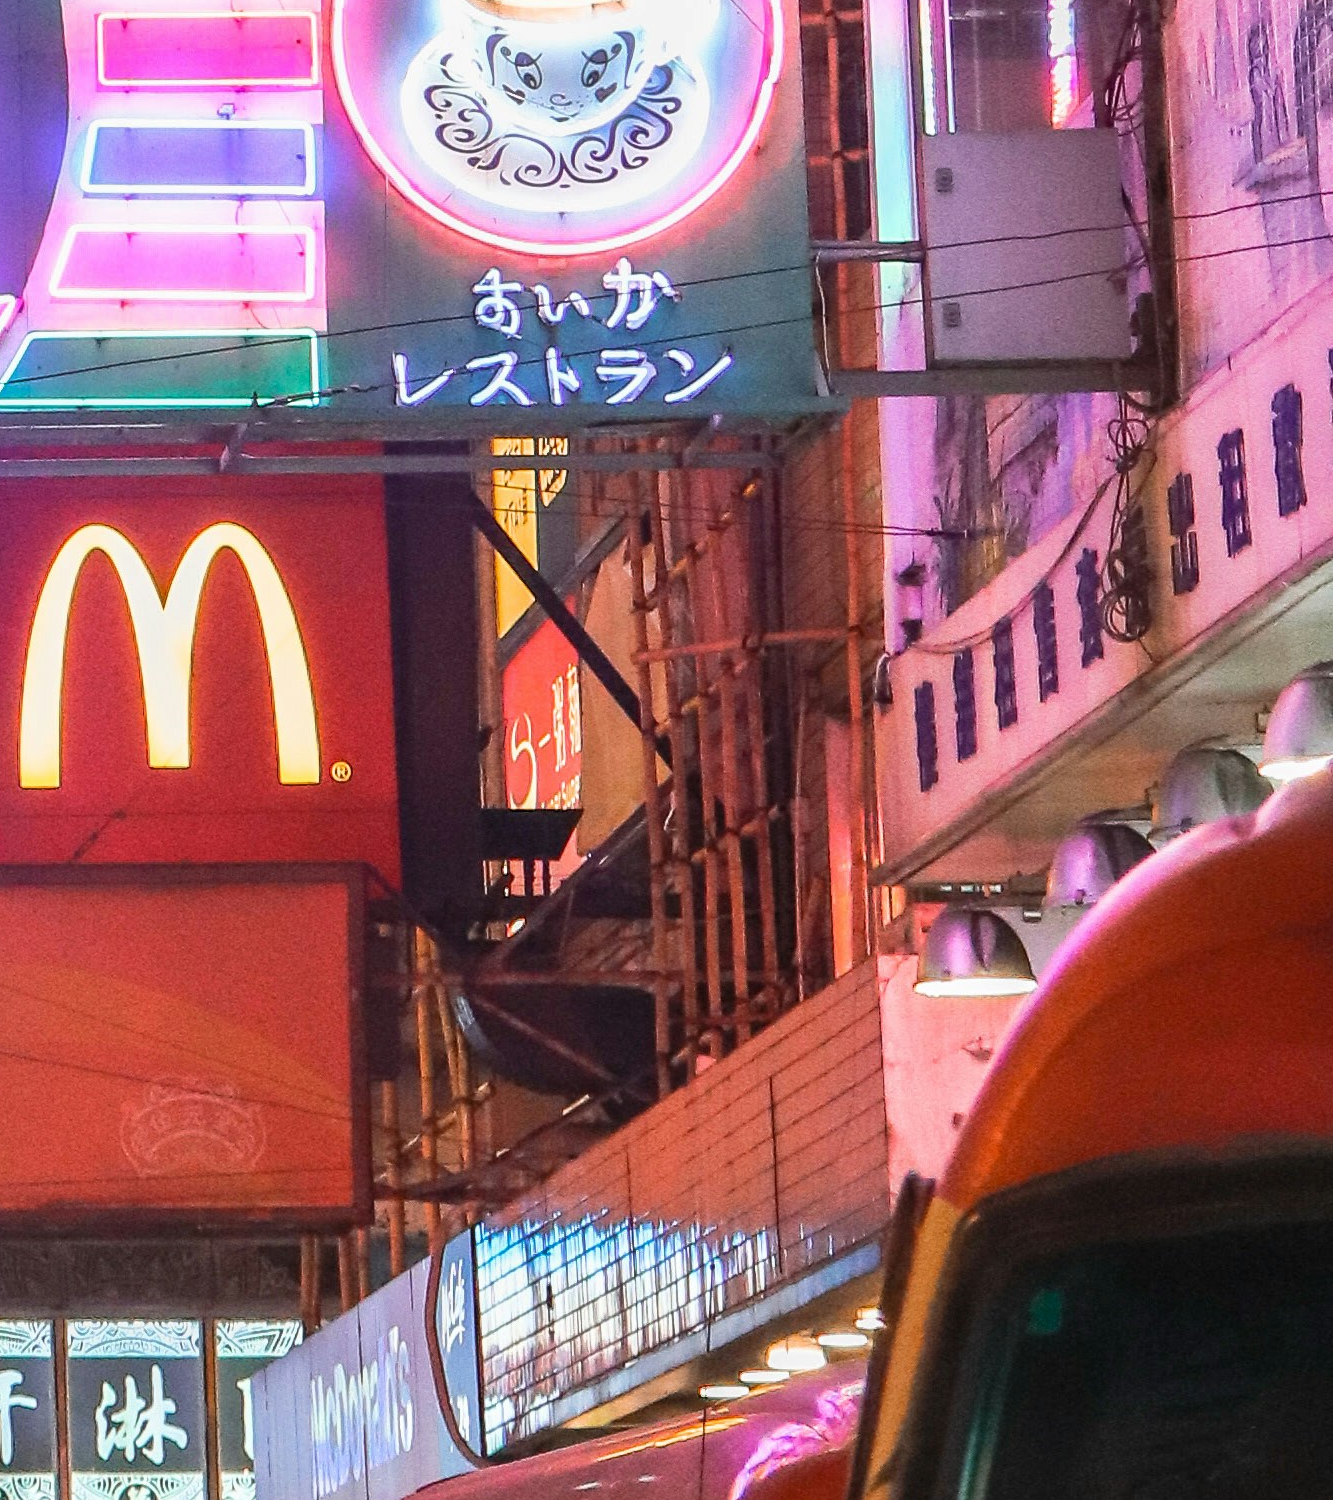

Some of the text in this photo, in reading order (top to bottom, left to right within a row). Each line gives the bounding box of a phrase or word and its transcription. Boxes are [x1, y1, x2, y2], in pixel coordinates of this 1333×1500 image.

[392, 345, 735, 406] レストラン
